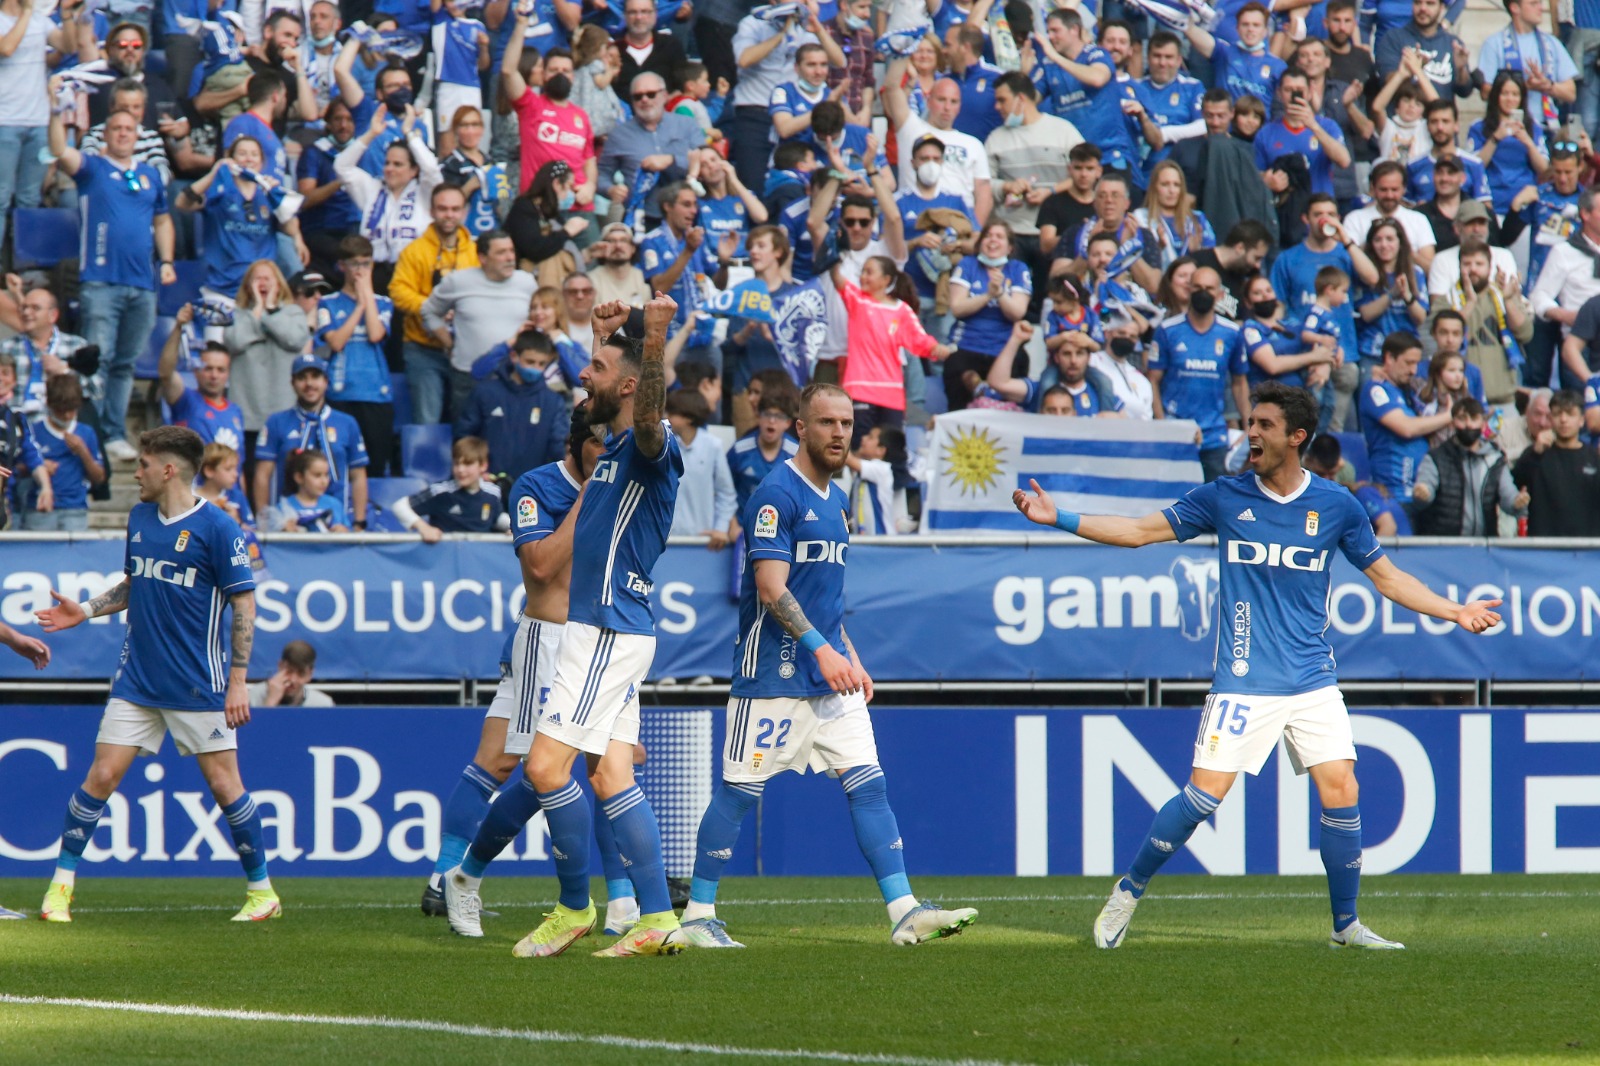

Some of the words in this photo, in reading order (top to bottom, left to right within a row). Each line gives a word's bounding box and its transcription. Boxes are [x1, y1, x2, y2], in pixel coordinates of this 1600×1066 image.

[1228, 540, 1329, 572] DIGI
[993, 575, 1180, 645] gam
[1233, 601, 1246, 658] OVIEDO
[754, 717, 792, 749] 22
[1217, 699, 1251, 736] 15
[0, 738, 550, 863] CaixaBa
[1015, 712, 1600, 876] INDIE
